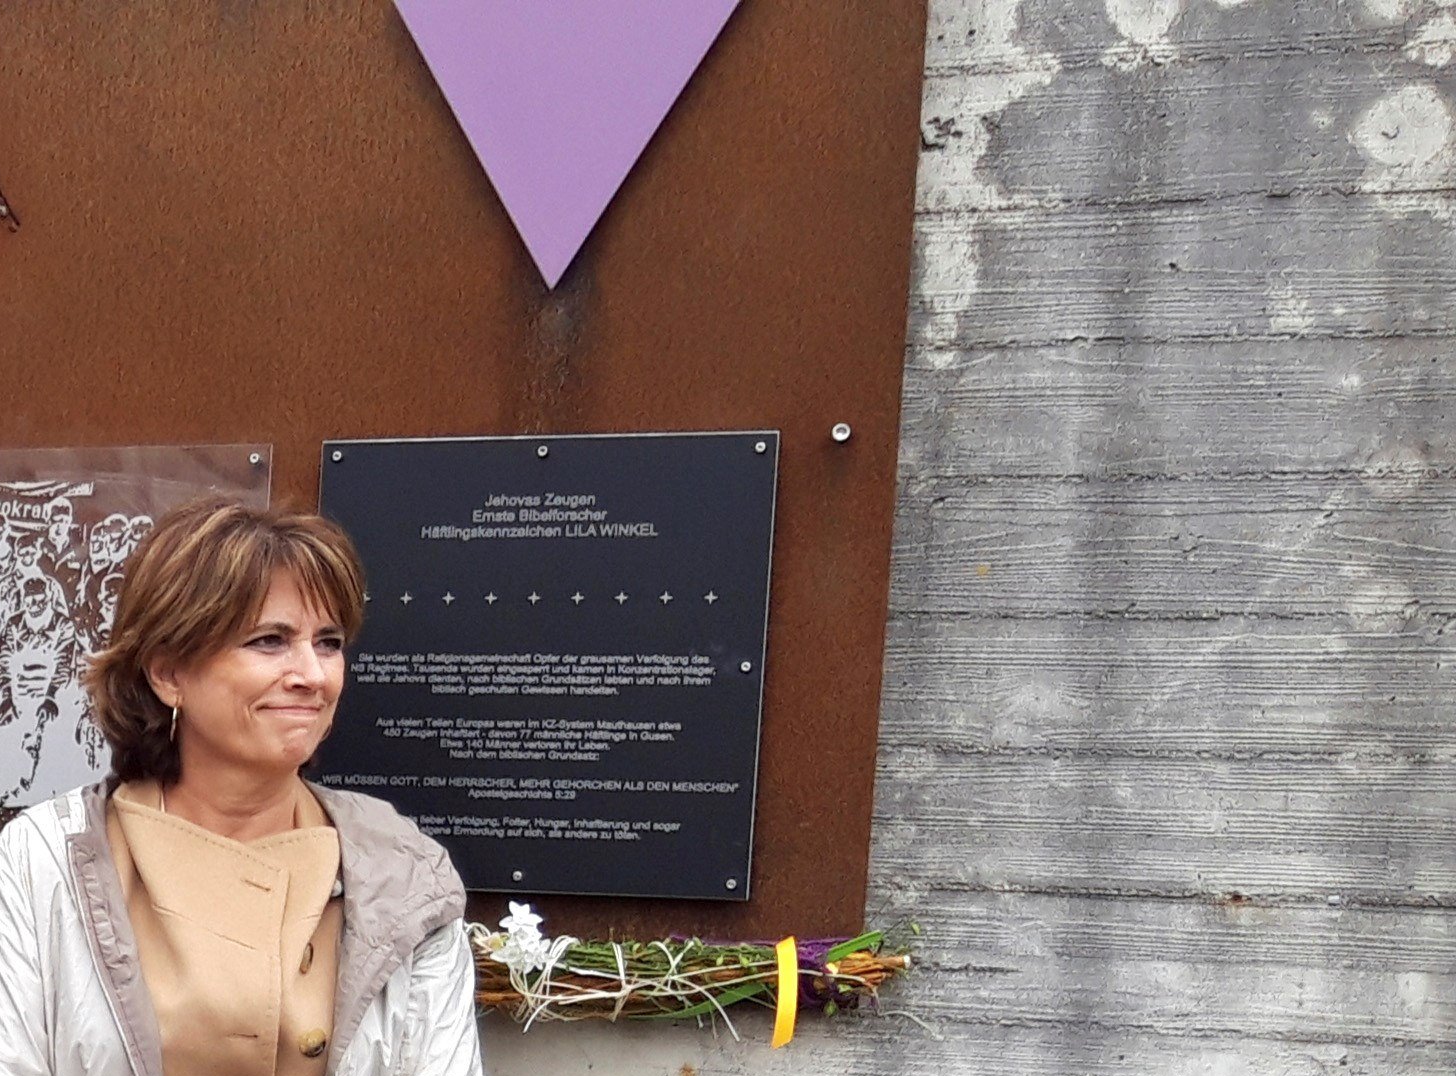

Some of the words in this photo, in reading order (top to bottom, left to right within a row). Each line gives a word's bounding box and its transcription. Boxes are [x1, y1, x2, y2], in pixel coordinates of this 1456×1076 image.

[484, 494, 541, 508] Jehovas
[544, 493, 596, 508] Zeugen
[519, 507, 608, 523] Bibelforscher
[421, 524, 562, 541] Häftlingskennzeichen
[565, 524, 595, 538] LILA
[599, 523, 659, 537] WINKEL
[359, 653, 373, 663] Sie
[375, 653, 409, 663] wurden
[411, 653, 425, 663] als
[427, 653, 531, 665] Religionsgemeinschaft
[533, 654, 561, 665] Opfer
[562, 654, 578, 663] der
[580, 655, 634, 666] grausamen
[636, 654, 689, 666] Verfolgung
[413, 663, 458, 673] Tausende
[460, 664, 494, 674] wurden
[552, 664, 570, 674] und
[572, 664, 604, 674] kamen
[606, 665, 616, 674] in
[357, 673, 375, 683] weil
[393, 674, 426, 683] Jehova
[467, 674, 490, 684] nach
[604, 674, 633, 684] lebten
[636, 675, 654, 685] und
[657, 676, 680, 685] nach
[431, 684, 466, 694] biblisch
[521, 685, 567, 695] Gewissen
[376, 717, 394, 727] Aus
[396, 717, 423, 727] vielen
[425, 717, 454, 727] Teilen
[456, 718, 494, 730] Europas
[497, 719, 526, 728] waren
[528, 718, 540, 728] im
[542, 719, 594, 731] KZ-System
[596, 720, 656, 730] Mauthausen
[658, 721, 682, 731] etwa
[402, 729, 437, 740] Zeugen
[488, 729, 517, 739] davon
[519, 730, 532, 739] 77
[533, 730, 582, 740] männliche
[584, 731, 626, 742] Häftlinge
[629, 731, 638, 740] in
[440, 739, 463, 748] Etwa
[466, 739, 483, 749] 140
[485, 739, 521, 749] Männer
[523, 740, 561, 750] verloren
[449, 749, 473, 758] Nach
[476, 749, 497, 759] dem
[499, 749, 544, 760] biblischen
[344, 773, 388, 786] MÜSSEN
[389, 776, 421, 788] GOTT,
[423, 777, 444, 788] DEM
[448, 777, 516, 789] HERRSCHER,
[519, 778, 550, 789] MEHR
[552, 779, 622, 791] GEHORCHEN
[623, 780, 644, 791] ALS
[646, 782, 670, 792] DEN
[467, 788, 553, 801] Apostelgeschichte
[453, 826, 505, 838] Ermordung
[506, 827, 523, 837] auf
[564, 829, 598, 839] andere
[600, 830, 612, 839] zu
[632, 820, 651, 831] und
[653, 821, 681, 833] sogar
